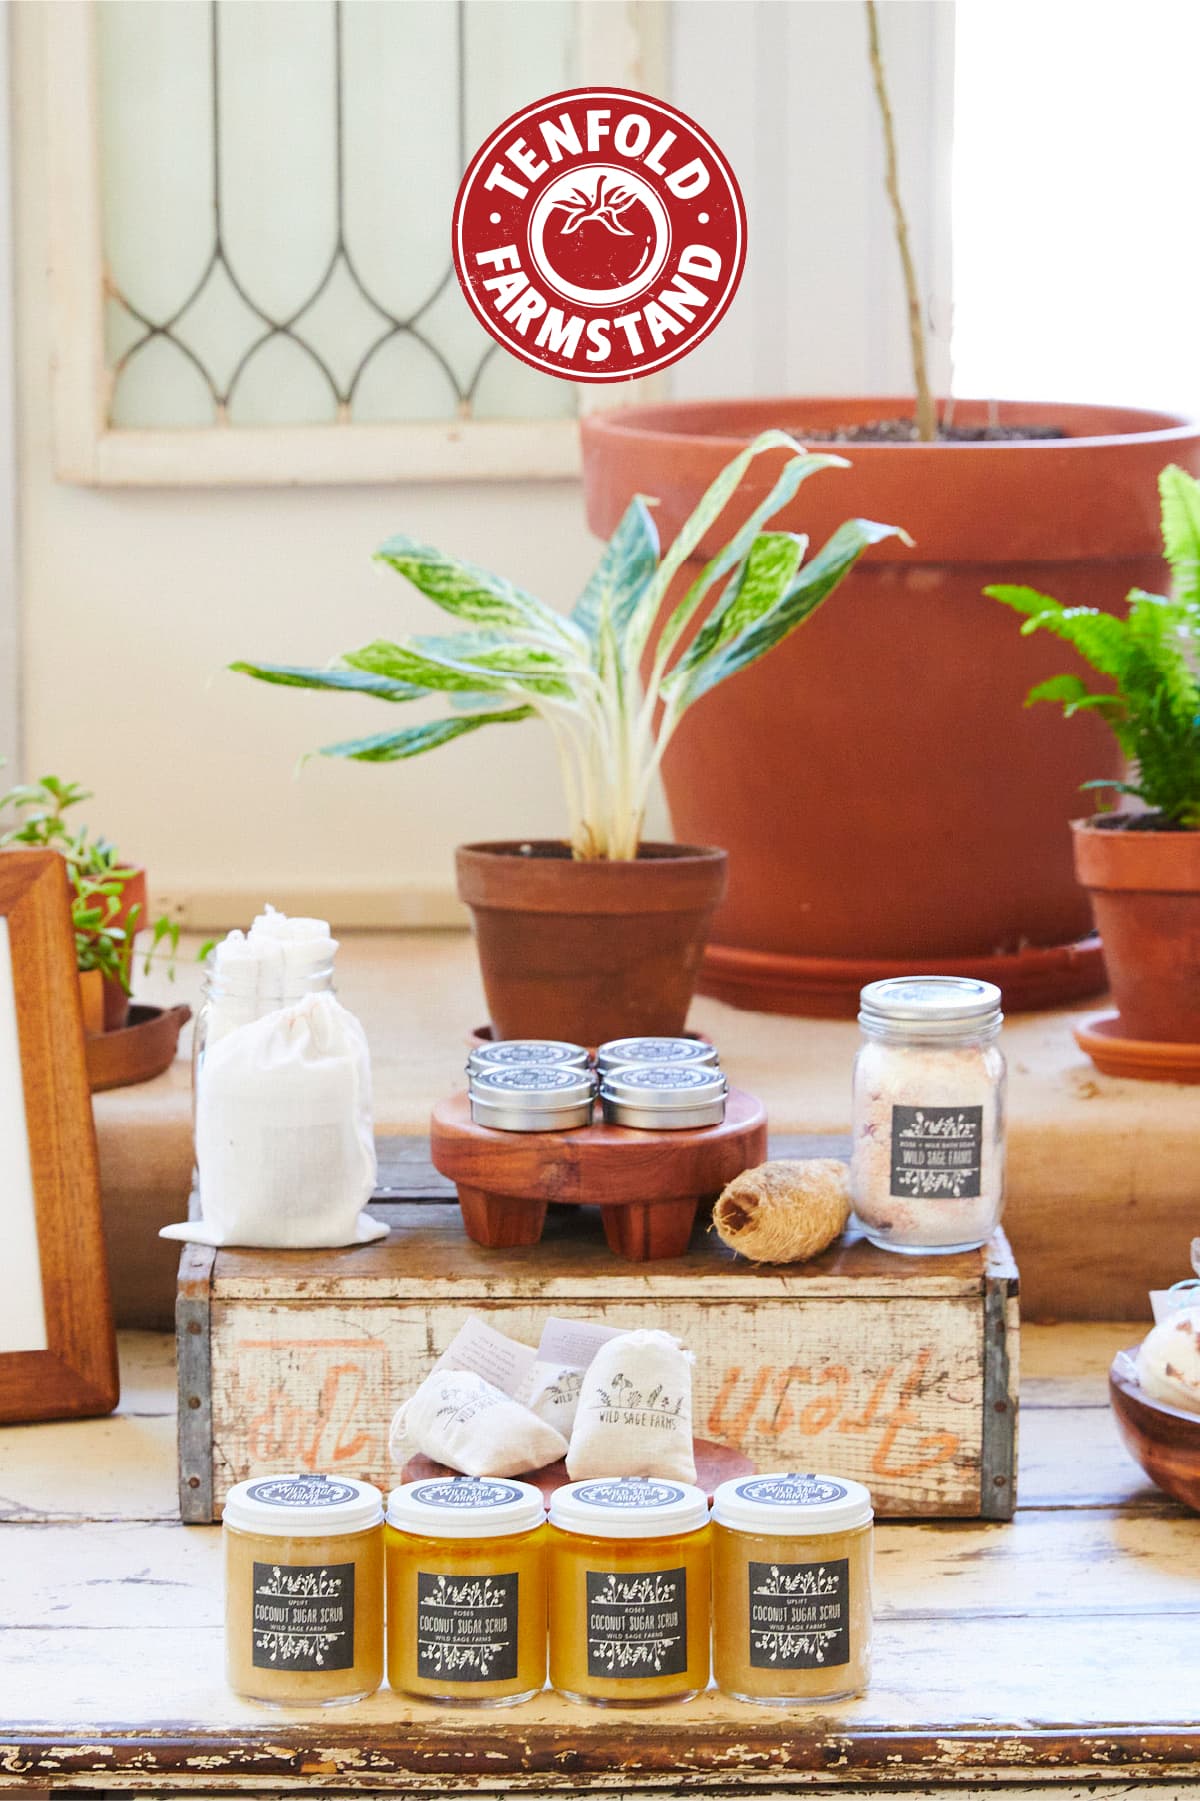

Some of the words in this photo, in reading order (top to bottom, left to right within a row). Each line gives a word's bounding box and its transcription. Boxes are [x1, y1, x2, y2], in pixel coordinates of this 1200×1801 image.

[600, 1410, 620, 1423] WILD
[624, 1411, 647, 1426] SAGE
[650, 1414, 676, 1431] FARMS
[279, 1485, 306, 1494] WILD
[440, 1487, 468, 1496] WILD
[601, 1487, 630, 1496] WILD
[766, 1485, 794, 1494] WILD
[255, 1604, 289, 1623] COCONUT
[293, 1608, 317, 1624] SUGAR
[320, 1606, 343, 1623] SCRUB
[590, 1614, 625, 1631] COCONUT
[629, 1615, 654, 1631] SUGAR
[657, 1611, 678, 1629] SCRUB
[753, 1605, 788, 1622] COCONUT
[791, 1606, 817, 1622] SUGAR
[819, 1603, 841, 1620] SCRUB
[420, 1615, 454, 1633] COCONUT
[458, 1619, 482, 1634] SUGAR
[485, 1617, 507, 1633] SCRUB
